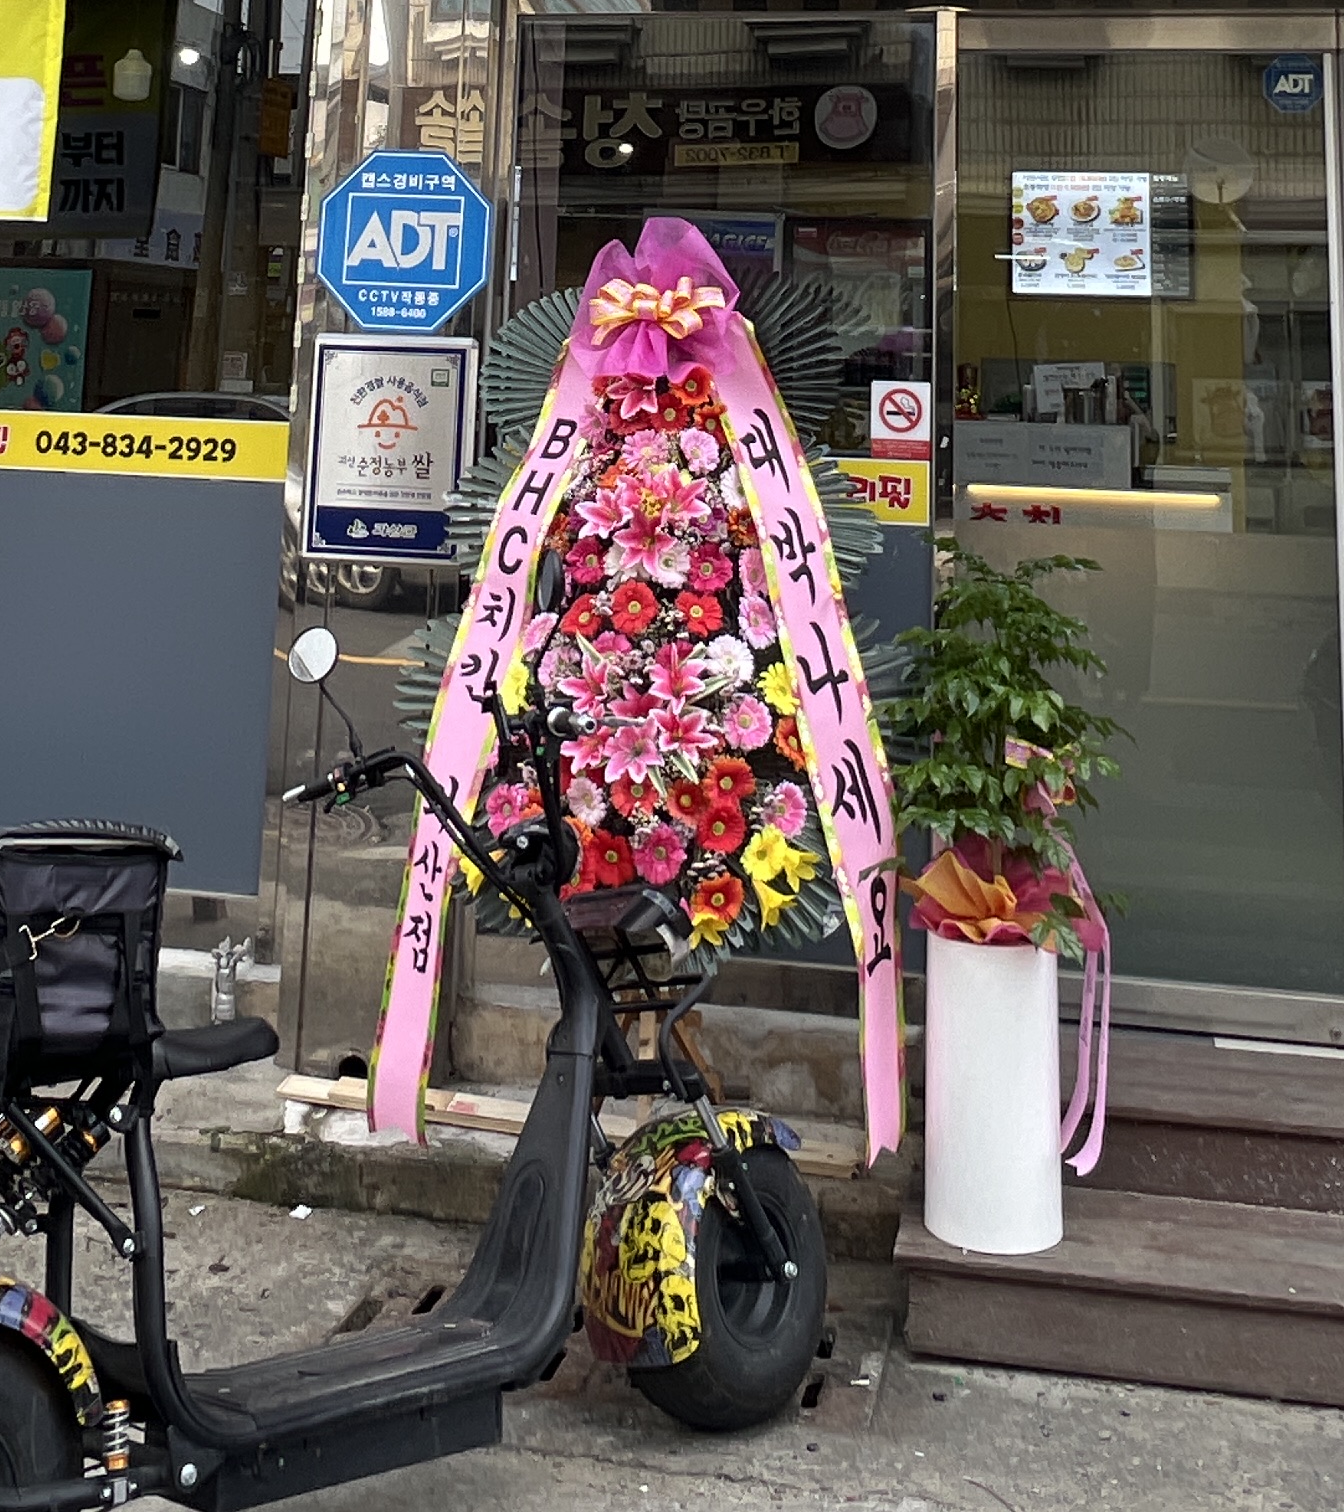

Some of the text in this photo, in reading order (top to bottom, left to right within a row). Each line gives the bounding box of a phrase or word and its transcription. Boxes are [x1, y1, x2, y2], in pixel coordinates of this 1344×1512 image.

[1272, 73, 1314, 94] ADT
[61, 129, 125, 169] 부터
[58, 177, 125, 214] 까지
[346, 209, 462, 271] ADT
[35, 429, 238, 464] 043-834-2929
